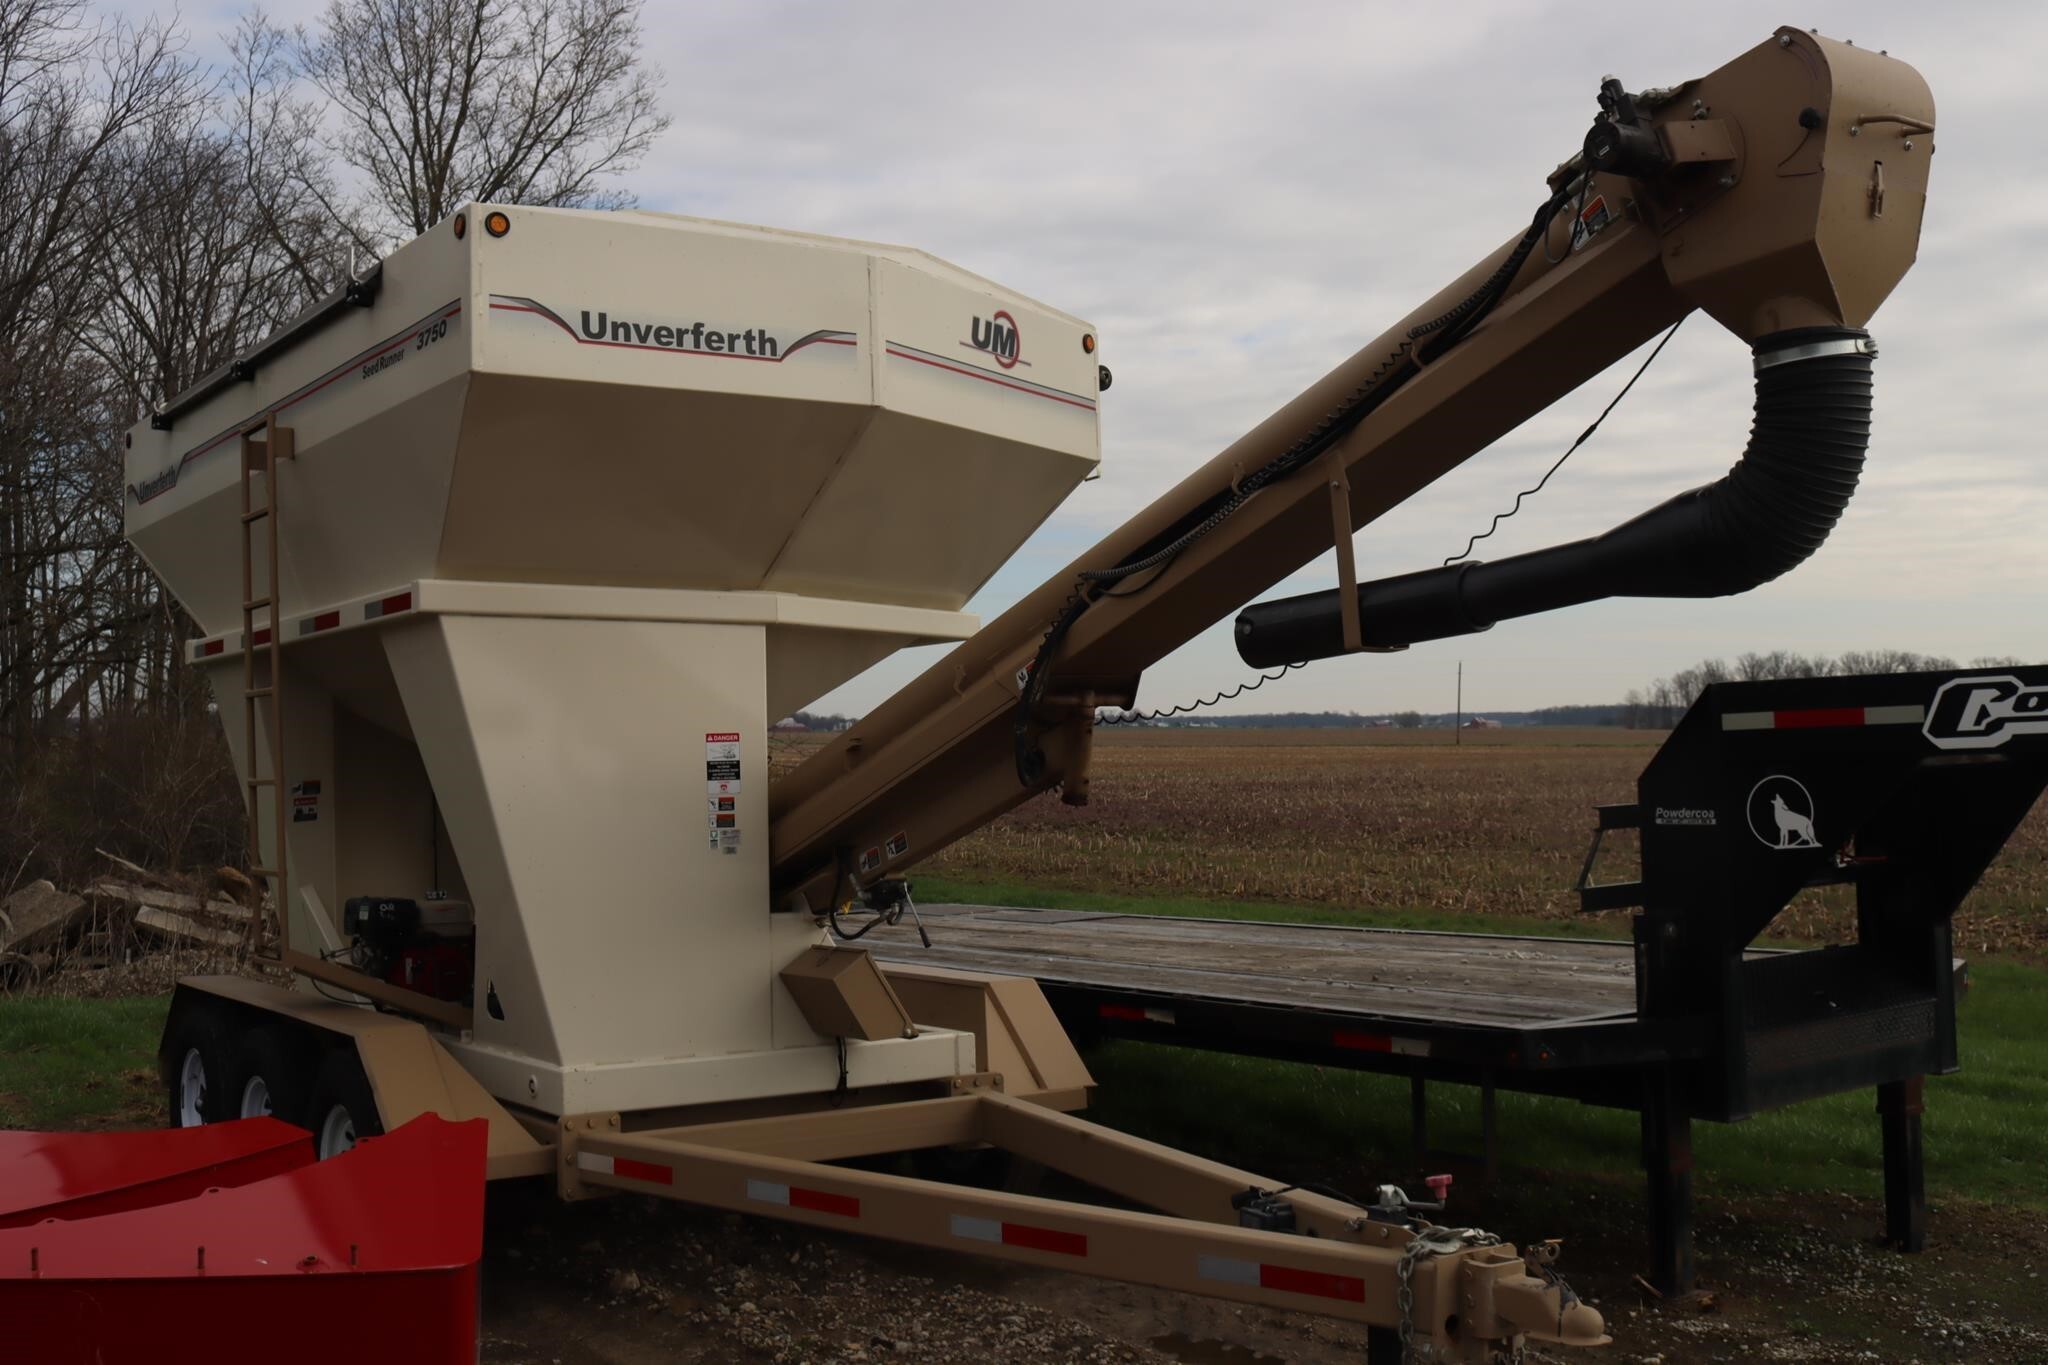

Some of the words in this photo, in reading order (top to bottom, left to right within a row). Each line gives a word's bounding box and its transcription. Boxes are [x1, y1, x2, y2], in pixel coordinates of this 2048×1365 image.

[416, 319, 447, 351] 3750
[581, 310, 778, 357] Unverferth
[971, 315, 1016, 358] UM
